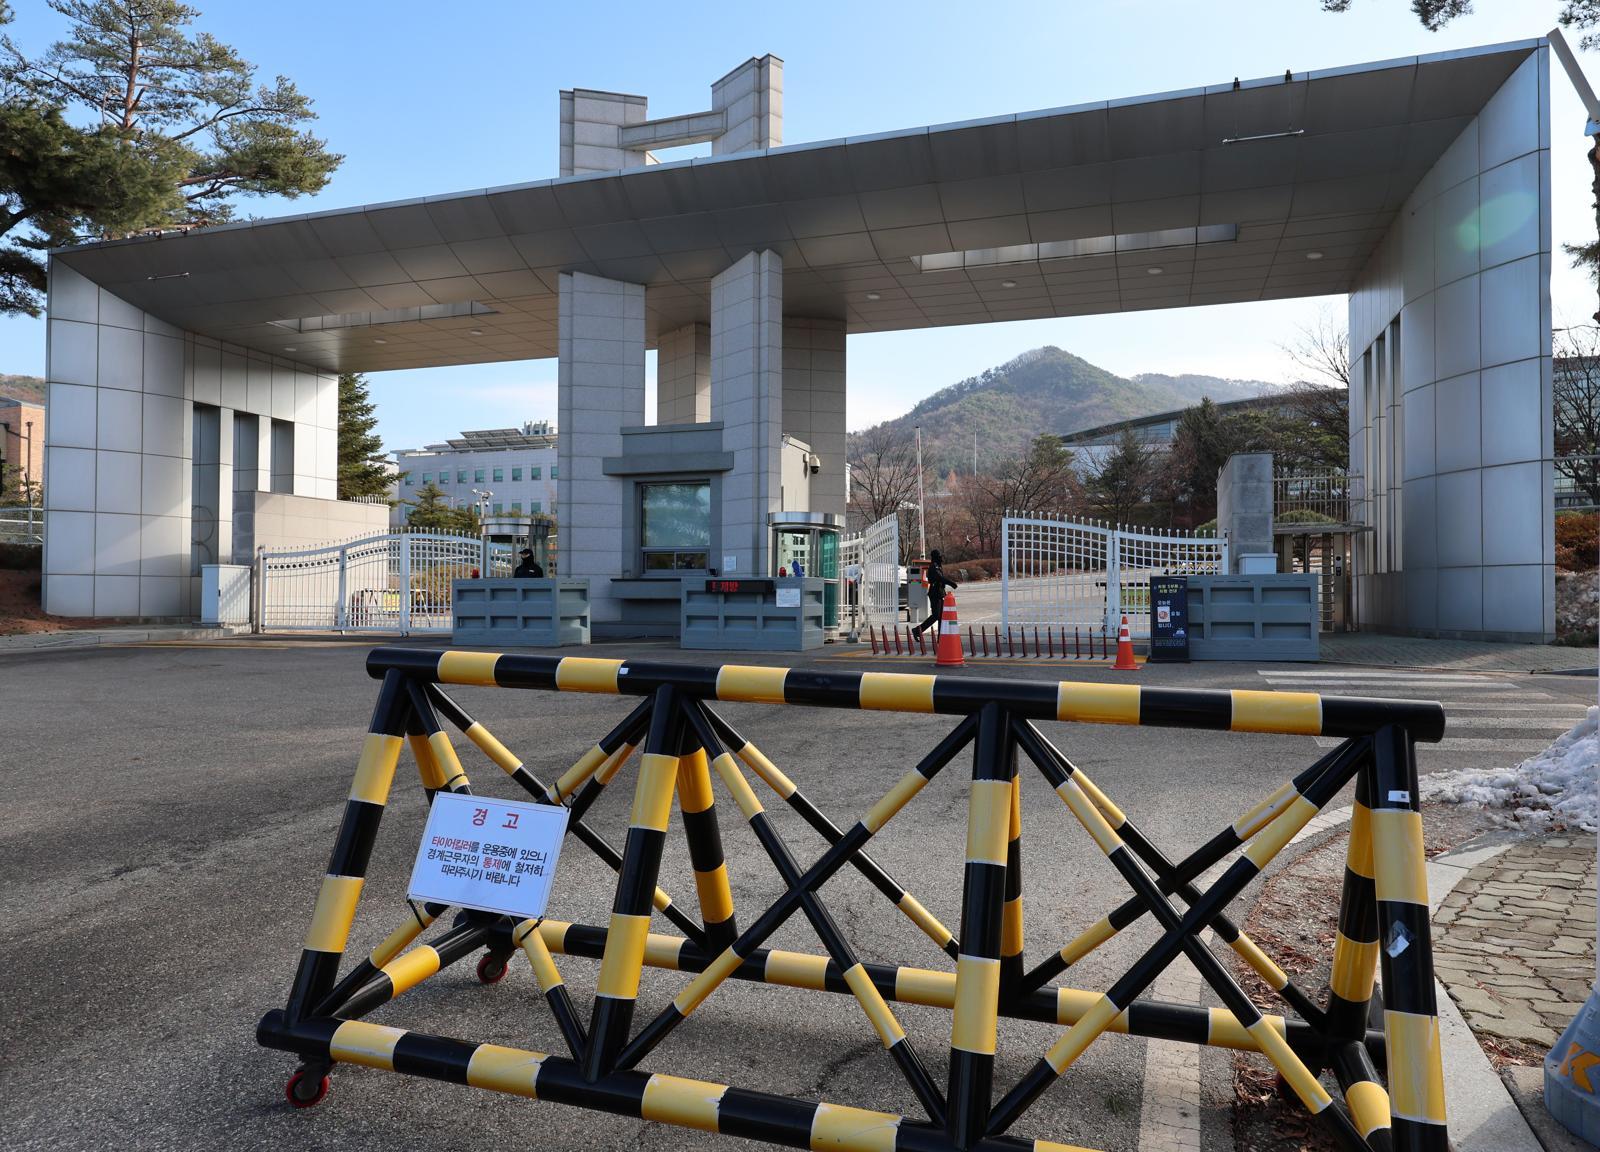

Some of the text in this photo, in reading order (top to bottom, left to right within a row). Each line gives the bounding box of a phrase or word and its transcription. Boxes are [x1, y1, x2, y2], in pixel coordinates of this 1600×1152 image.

[472, 808, 520, 830] 경 고
[432, 836, 547, 863] 타이어킬러를 운용중에 있으니
[428, 848, 544, 877] 경계근무자의 통제에 철저히
[441, 863, 520, 887] 따라주시기 바랍니다
